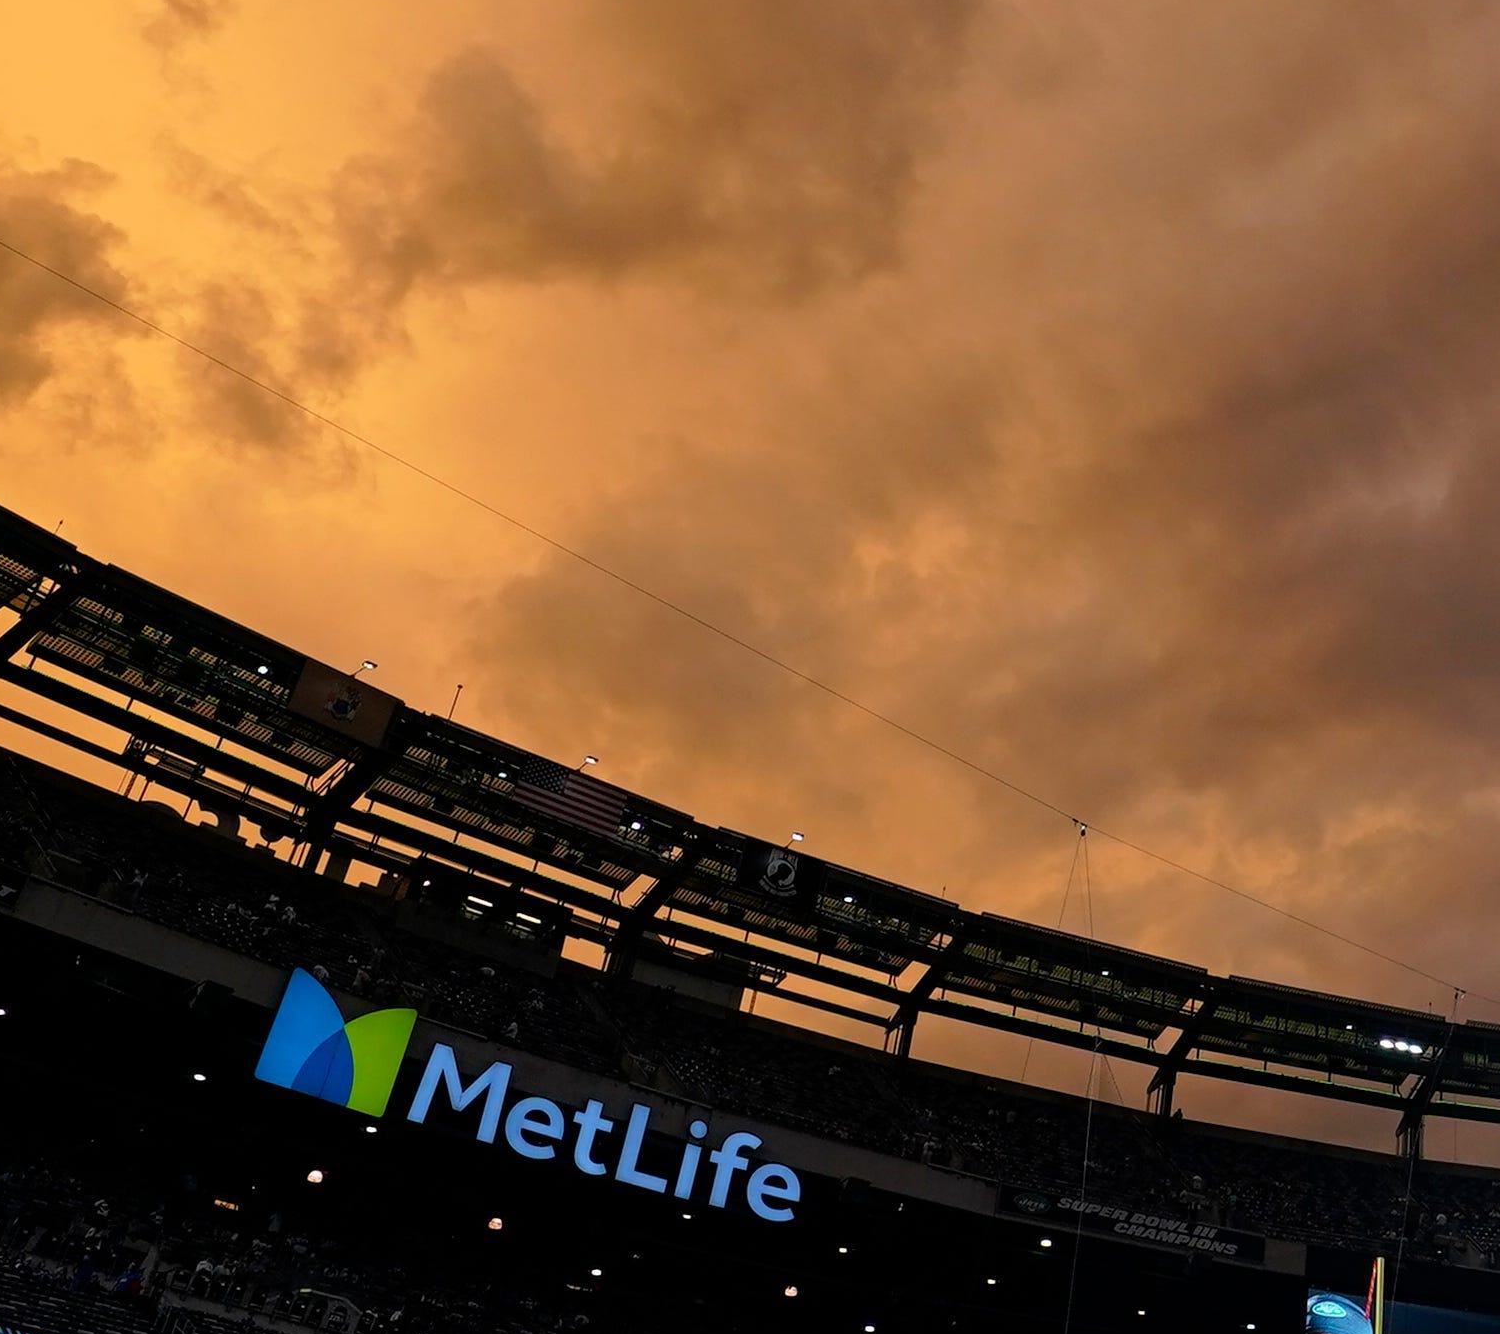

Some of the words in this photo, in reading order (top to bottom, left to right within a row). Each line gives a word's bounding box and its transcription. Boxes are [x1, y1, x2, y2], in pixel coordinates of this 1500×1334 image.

[407, 1042, 802, 1223] MetLife
[1056, 1196, 1129, 1222] SUPER
[1129, 1212, 1189, 1234] BOWL
[1191, 1223, 1220, 1239] III
[1113, 1222, 1239, 1256] CHAMPIONS
